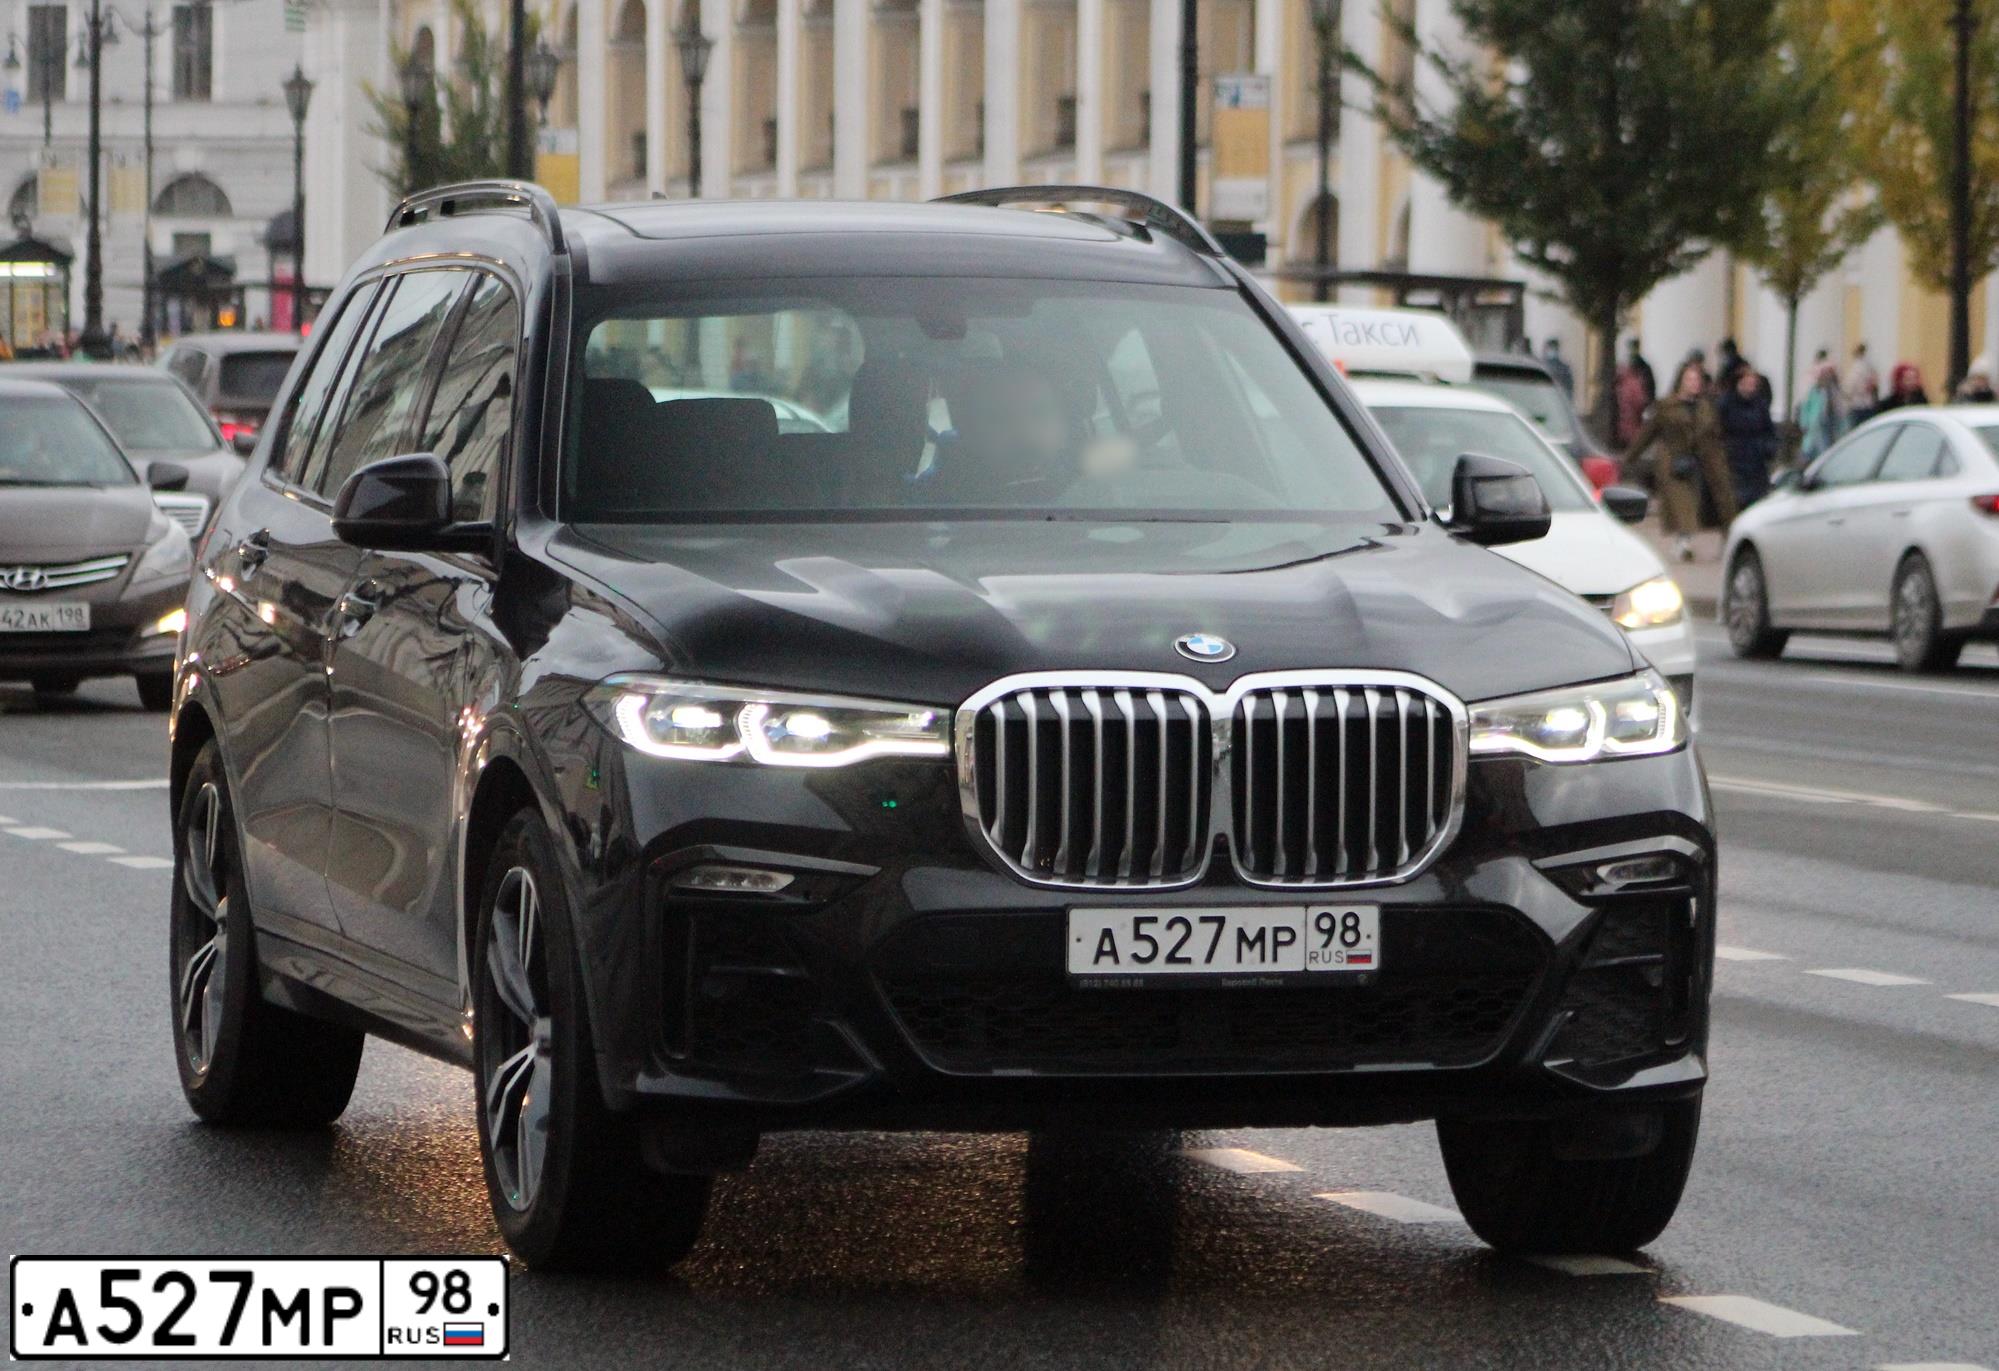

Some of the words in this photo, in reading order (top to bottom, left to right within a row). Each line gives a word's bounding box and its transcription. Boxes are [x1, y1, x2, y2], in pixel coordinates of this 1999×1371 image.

[1320, 313, 1421, 348] Такси
[1314, 911, 1361, 949] 98
[1309, 951, 1344, 964] RUS
